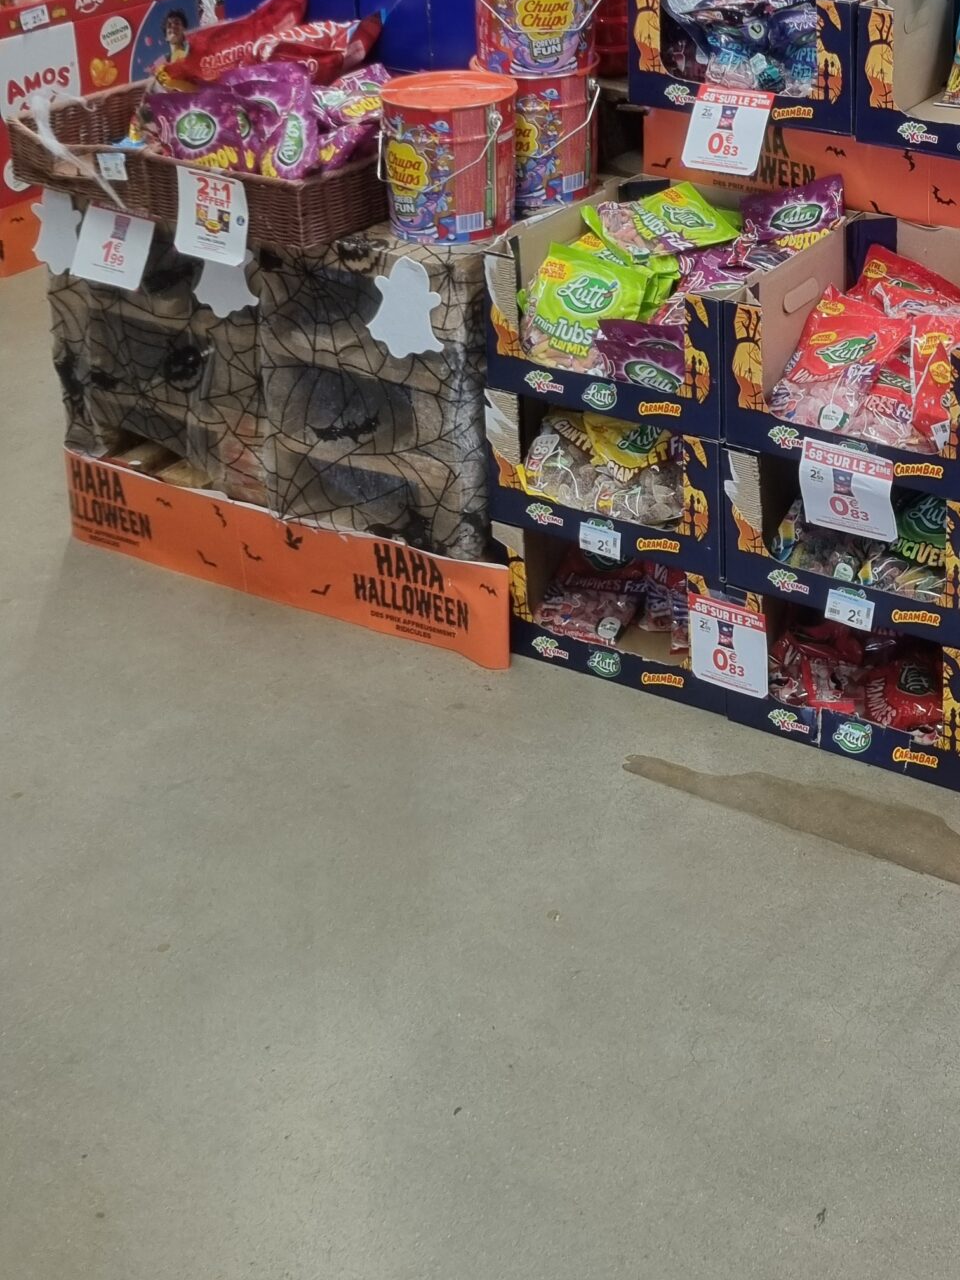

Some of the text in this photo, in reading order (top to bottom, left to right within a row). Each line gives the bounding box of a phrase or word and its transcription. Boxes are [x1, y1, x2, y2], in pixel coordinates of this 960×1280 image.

[524, 0, 569, 15] Chupa
[521, 13, 567, 29] Chups
[533, 38, 561, 49] FOREVER
[533, 45, 562, 58] FUN
[7, 66, 70, 105] AMOS
[719, 94, 736, 105] SUR
[738, 97, 750, 106] LE
[772, 106, 813, 120] CARAMBAR
[707, 132, 738, 157] 0€83
[388, 152, 421, 171] Chupa
[388, 167, 420, 186] Chups
[728, 182, 745, 190] PRIX
[196, 176, 232, 201] 2+1
[196, 195, 232, 208] OFFERT
[395, 202, 415, 213] FUN
[557, 276, 610, 309] Lutti
[534, 317, 593, 344] mini Tubs
[816, 334, 869, 367] Lutti
[583, 384, 615, 406] Lutti
[639, 401, 682, 417] CARAMBAR
[805, 448, 890, 475] -68% SUR LE 2ÈME
[893, 462, 944, 479] CARAMBAR
[70, 457, 127, 507] HAHA
[829, 496, 869, 520] 0€83
[637, 537, 680, 552] CARAMBAR
[373, 542, 444, 593] HAHA
[353, 573, 468, 634] HALLOWEEN
[370, 610, 456, 639] DES PRIX AFFREUSEMENT
[711, 607, 730, 620] SUR
[732, 614, 743, 623] LE
[892, 609, 941, 626] CARAMBAR
[395, 624, 431, 639] RIDICULES
[589, 653, 618, 672] Lutti
[713, 649, 745, 678] 0€83
[641, 672, 684, 688] CARAMBAR
[835, 726, 869, 748] Lutti
[893, 747, 939, 768] CARAMBAR
